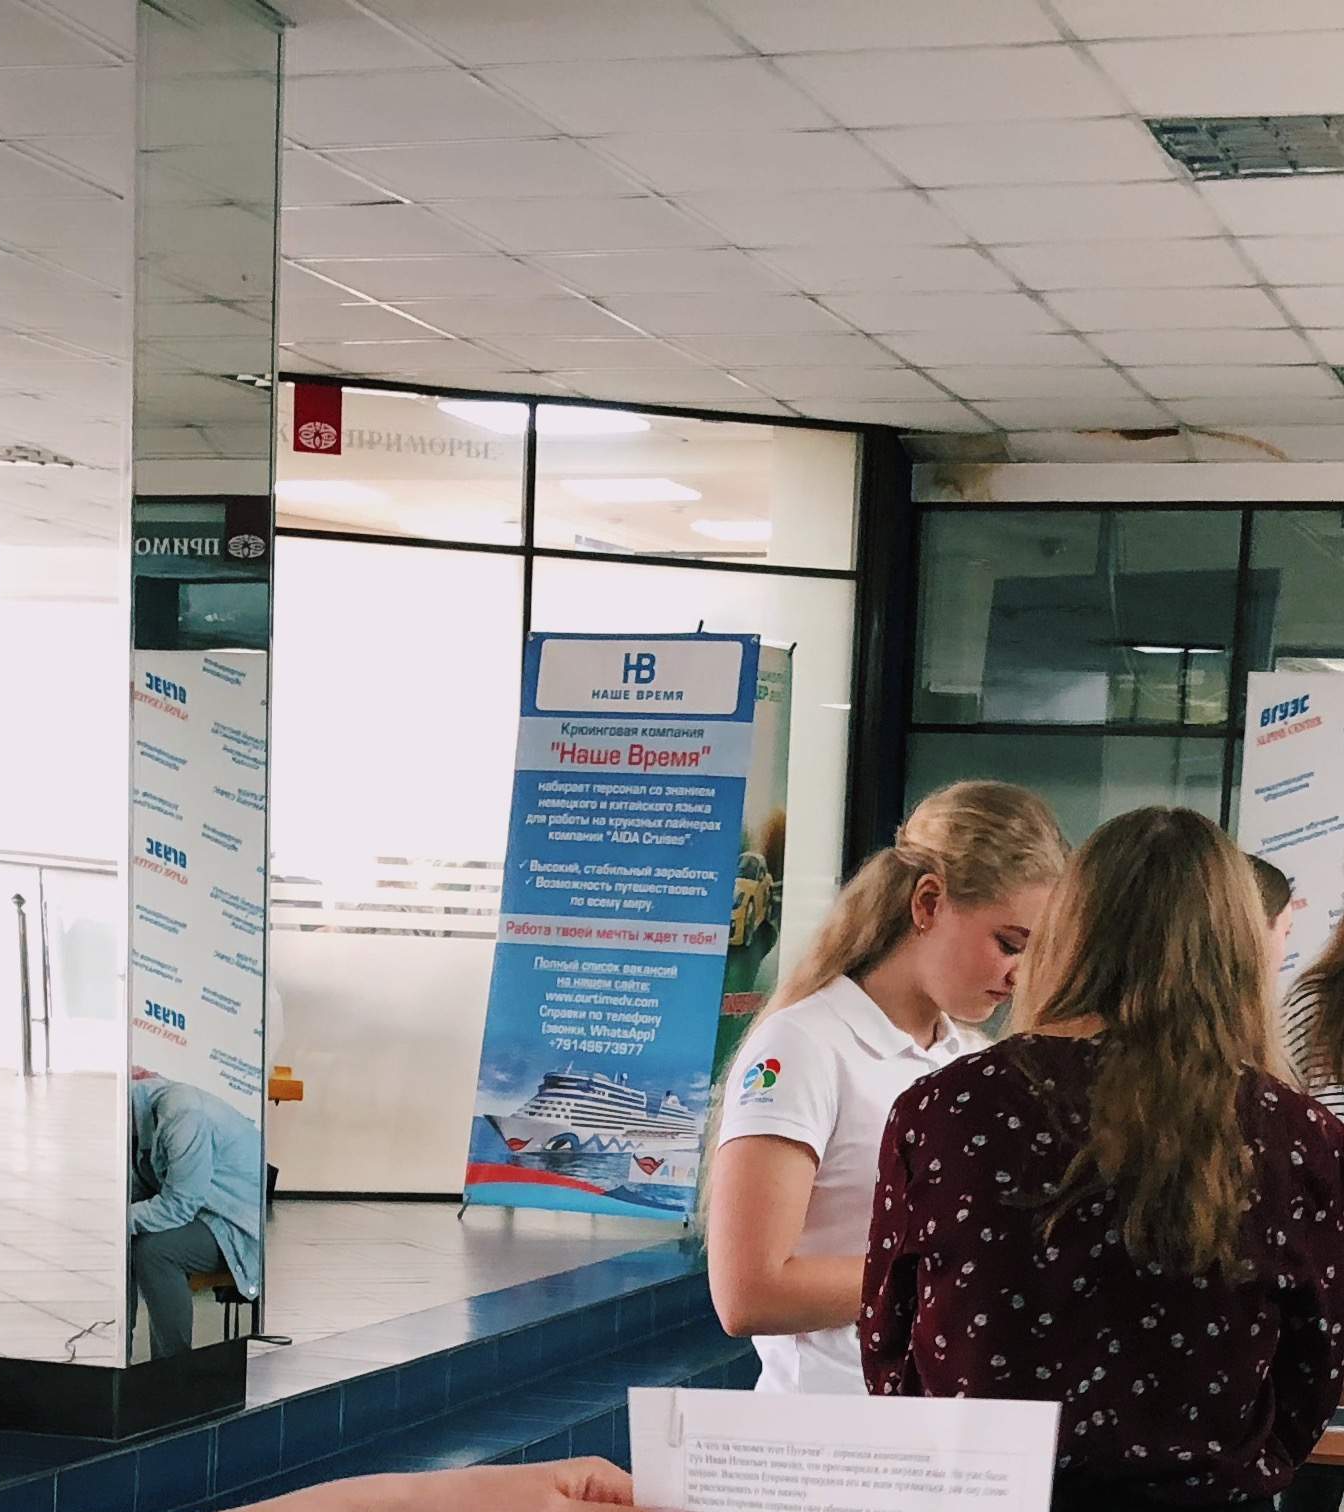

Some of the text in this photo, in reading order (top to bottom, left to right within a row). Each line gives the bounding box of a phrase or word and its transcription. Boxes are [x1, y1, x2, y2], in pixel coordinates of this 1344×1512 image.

[592, 690, 683, 701] НАШЕ ВРЕМЯ
[1260, 694, 1310, 727] ВГУЭС
[561, 722, 704, 739] Крюинговая компания
[551, 742, 711, 770] "Наше Время"
[506, 920, 551, 937] Работа
[556, 924, 593, 938] твоей
[596, 928, 639, 941] мечты
[683, 933, 717, 946] тебя!
[588, 1009, 603, 1021] по
